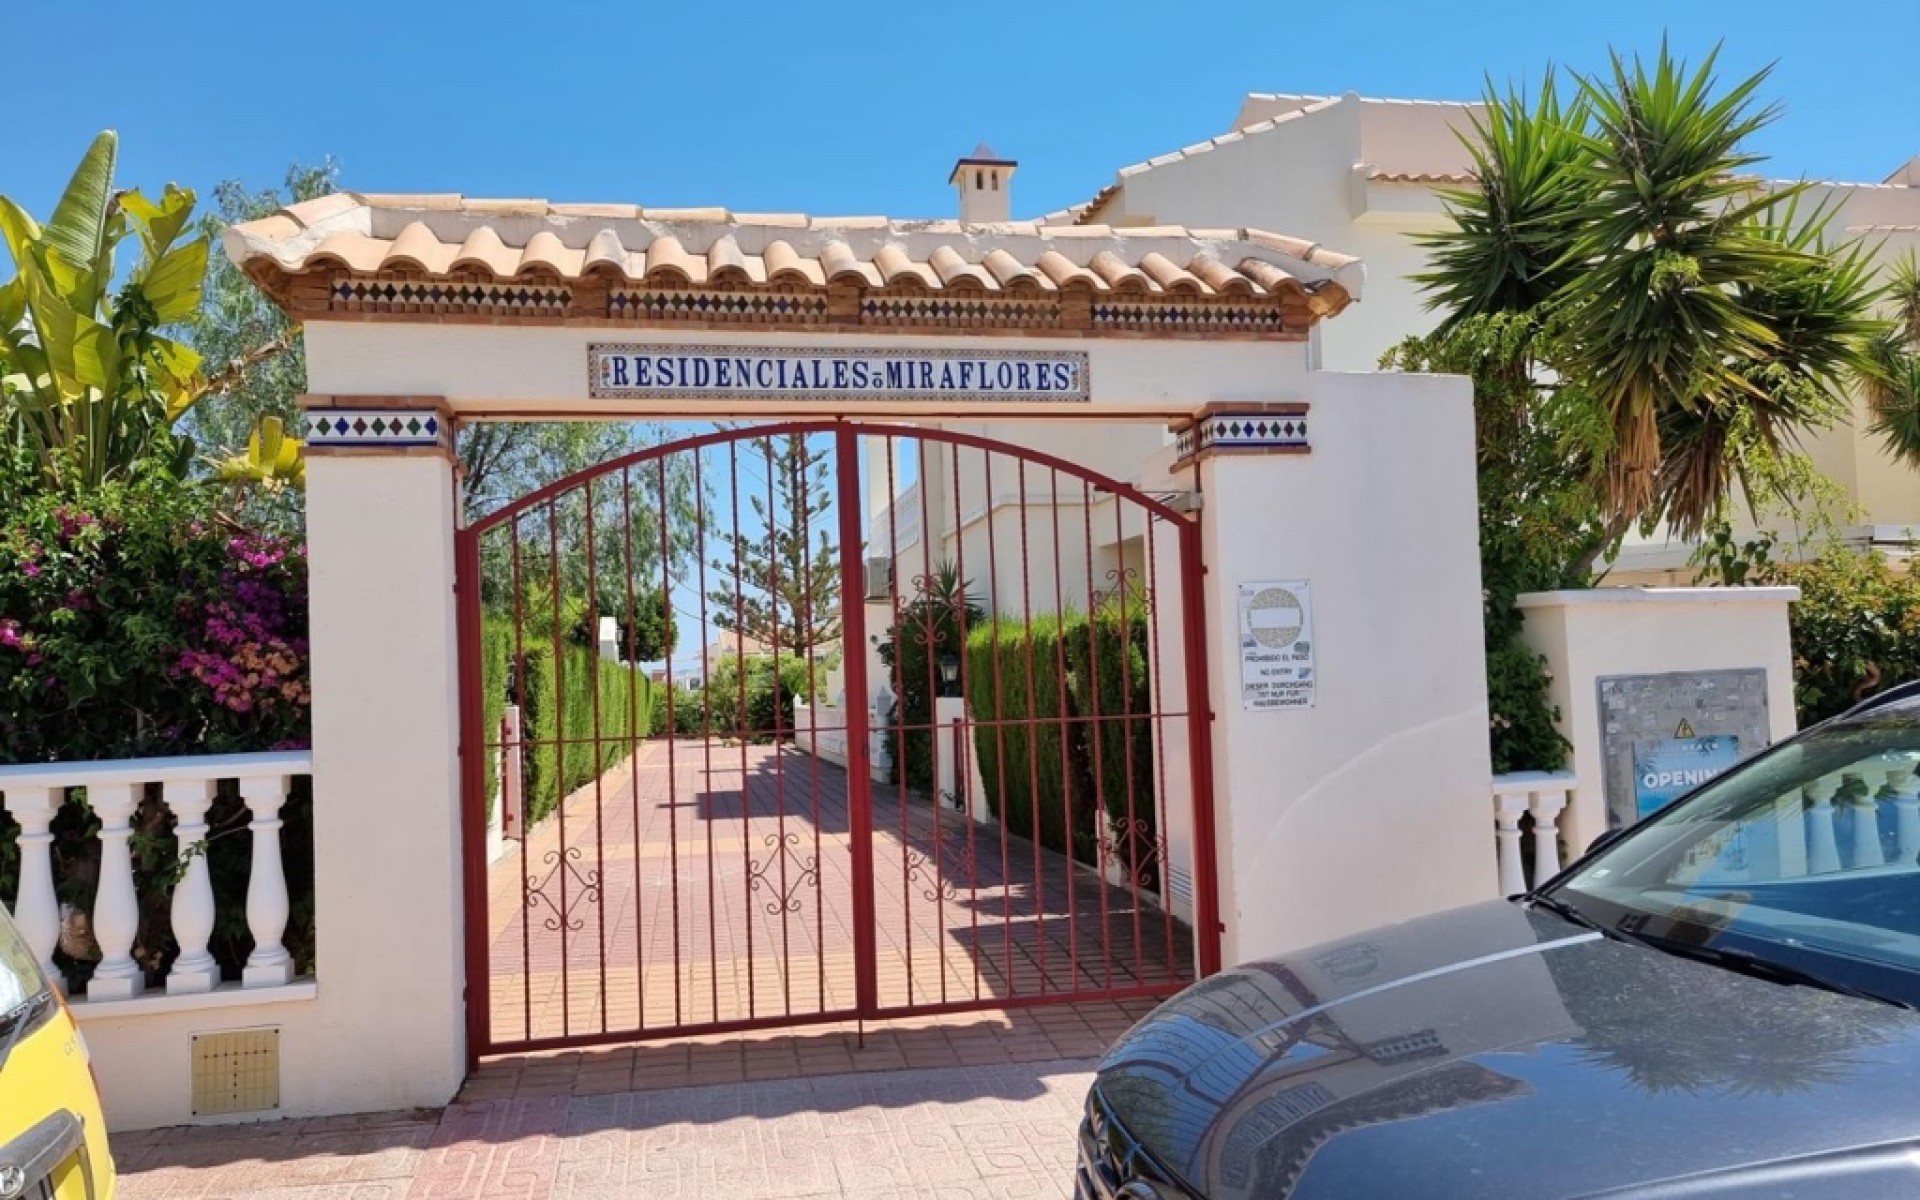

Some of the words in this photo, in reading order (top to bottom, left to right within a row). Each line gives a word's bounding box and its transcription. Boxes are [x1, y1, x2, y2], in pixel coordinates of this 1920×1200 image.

[612, 356, 869, 389] RESIDENCIALES
[886, 361, 1070, 390] MIRAFLORES
[1643, 767, 1726, 789] OPENIN
